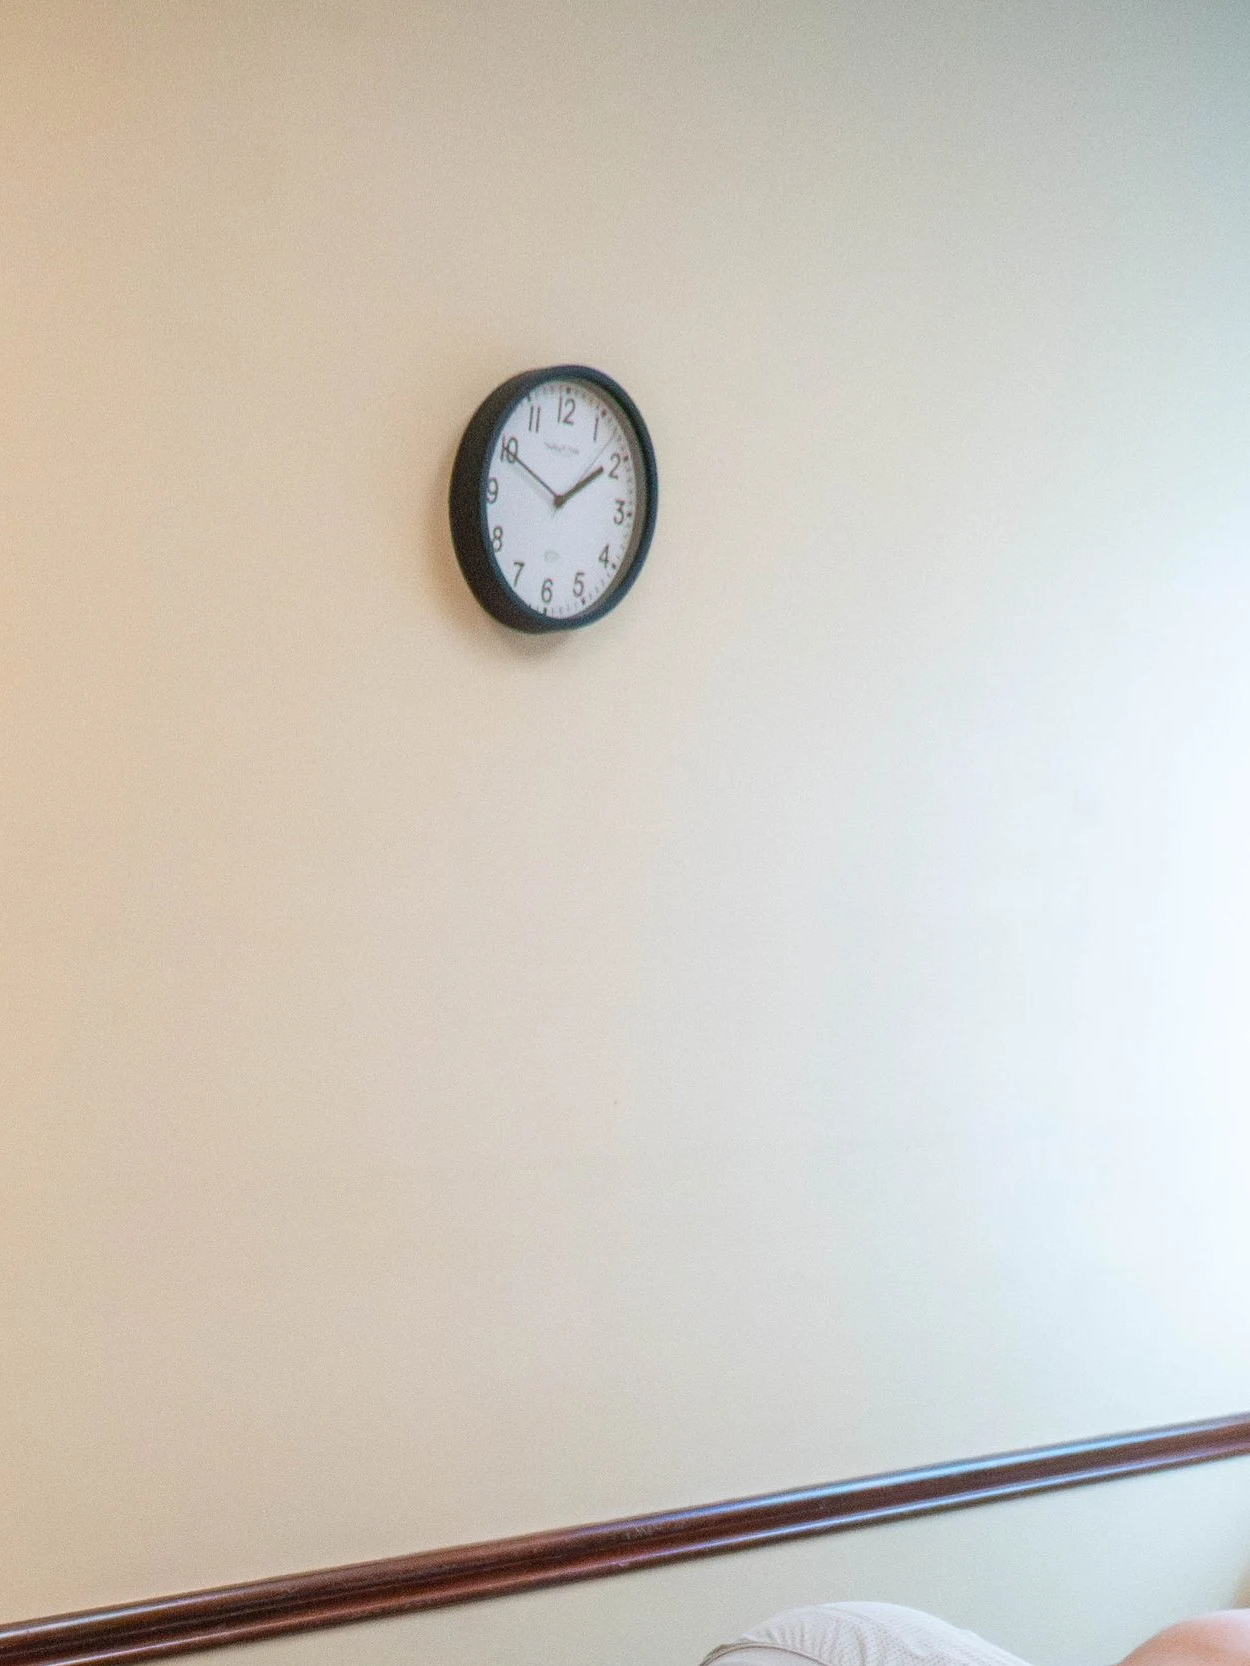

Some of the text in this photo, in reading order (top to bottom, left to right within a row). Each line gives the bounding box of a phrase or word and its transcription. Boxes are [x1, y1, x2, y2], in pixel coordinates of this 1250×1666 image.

[528, 406, 541, 433] 11
[557, 396, 576, 425] 12
[593, 417, 599, 442] 1
[500, 437, 519, 464] 10
[608, 453, 621, 479] 2
[485, 477, 499, 504] 9
[613, 501, 625, 525] 3
[492, 526, 503, 553] 8
[598, 544, 610, 568] 4
[513, 562, 525, 586] 7
[572, 572, 585, 597] 5
[541, 579, 554, 604] 6
